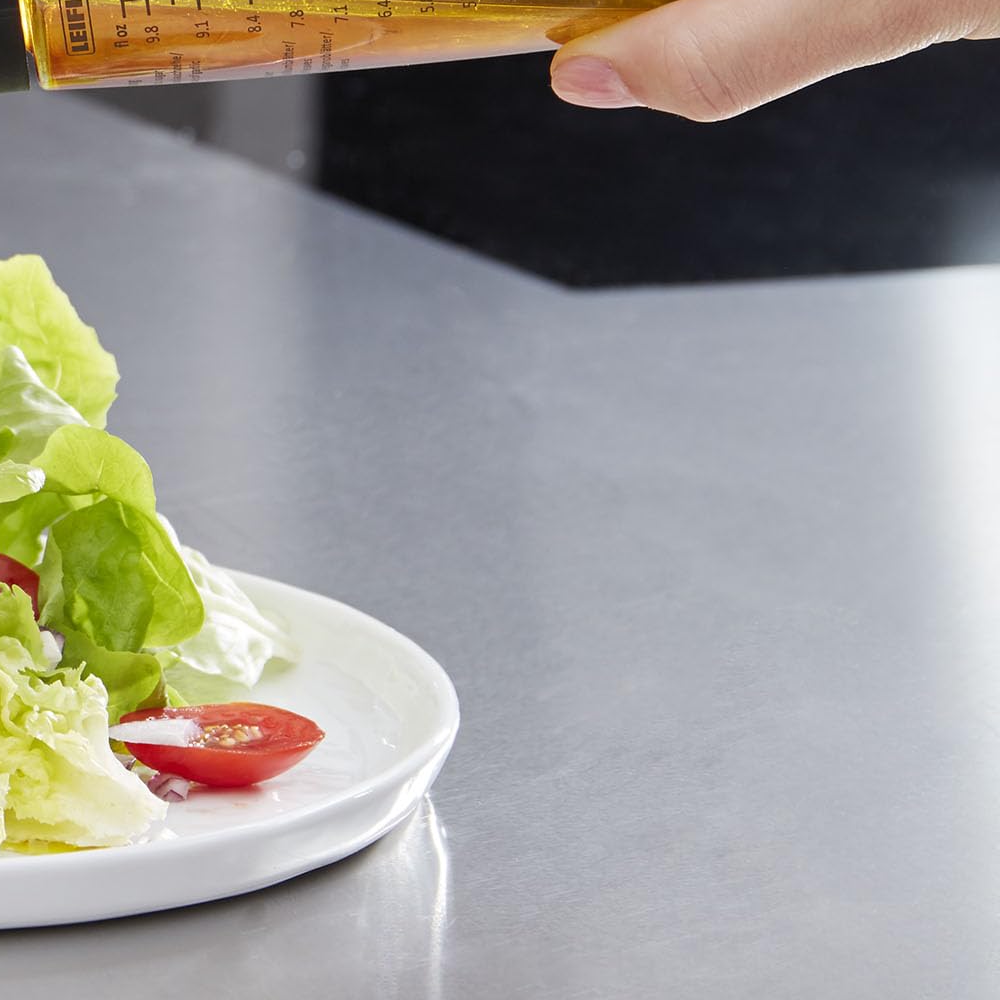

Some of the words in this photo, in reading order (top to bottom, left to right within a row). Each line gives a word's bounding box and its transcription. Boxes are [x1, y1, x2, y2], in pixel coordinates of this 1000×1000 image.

[334, 5, 349, 23] 7.1
[377, 0, 393, 18] 6.4
[246, 14, 262, 33] 8.4
[289, 9, 305, 28] 7.8
[116, 24, 128, 38] oz
[144, 25, 160, 44] 9.8
[194, 20, 210, 38] 9.1
[114, 40, 129, 48] fl
